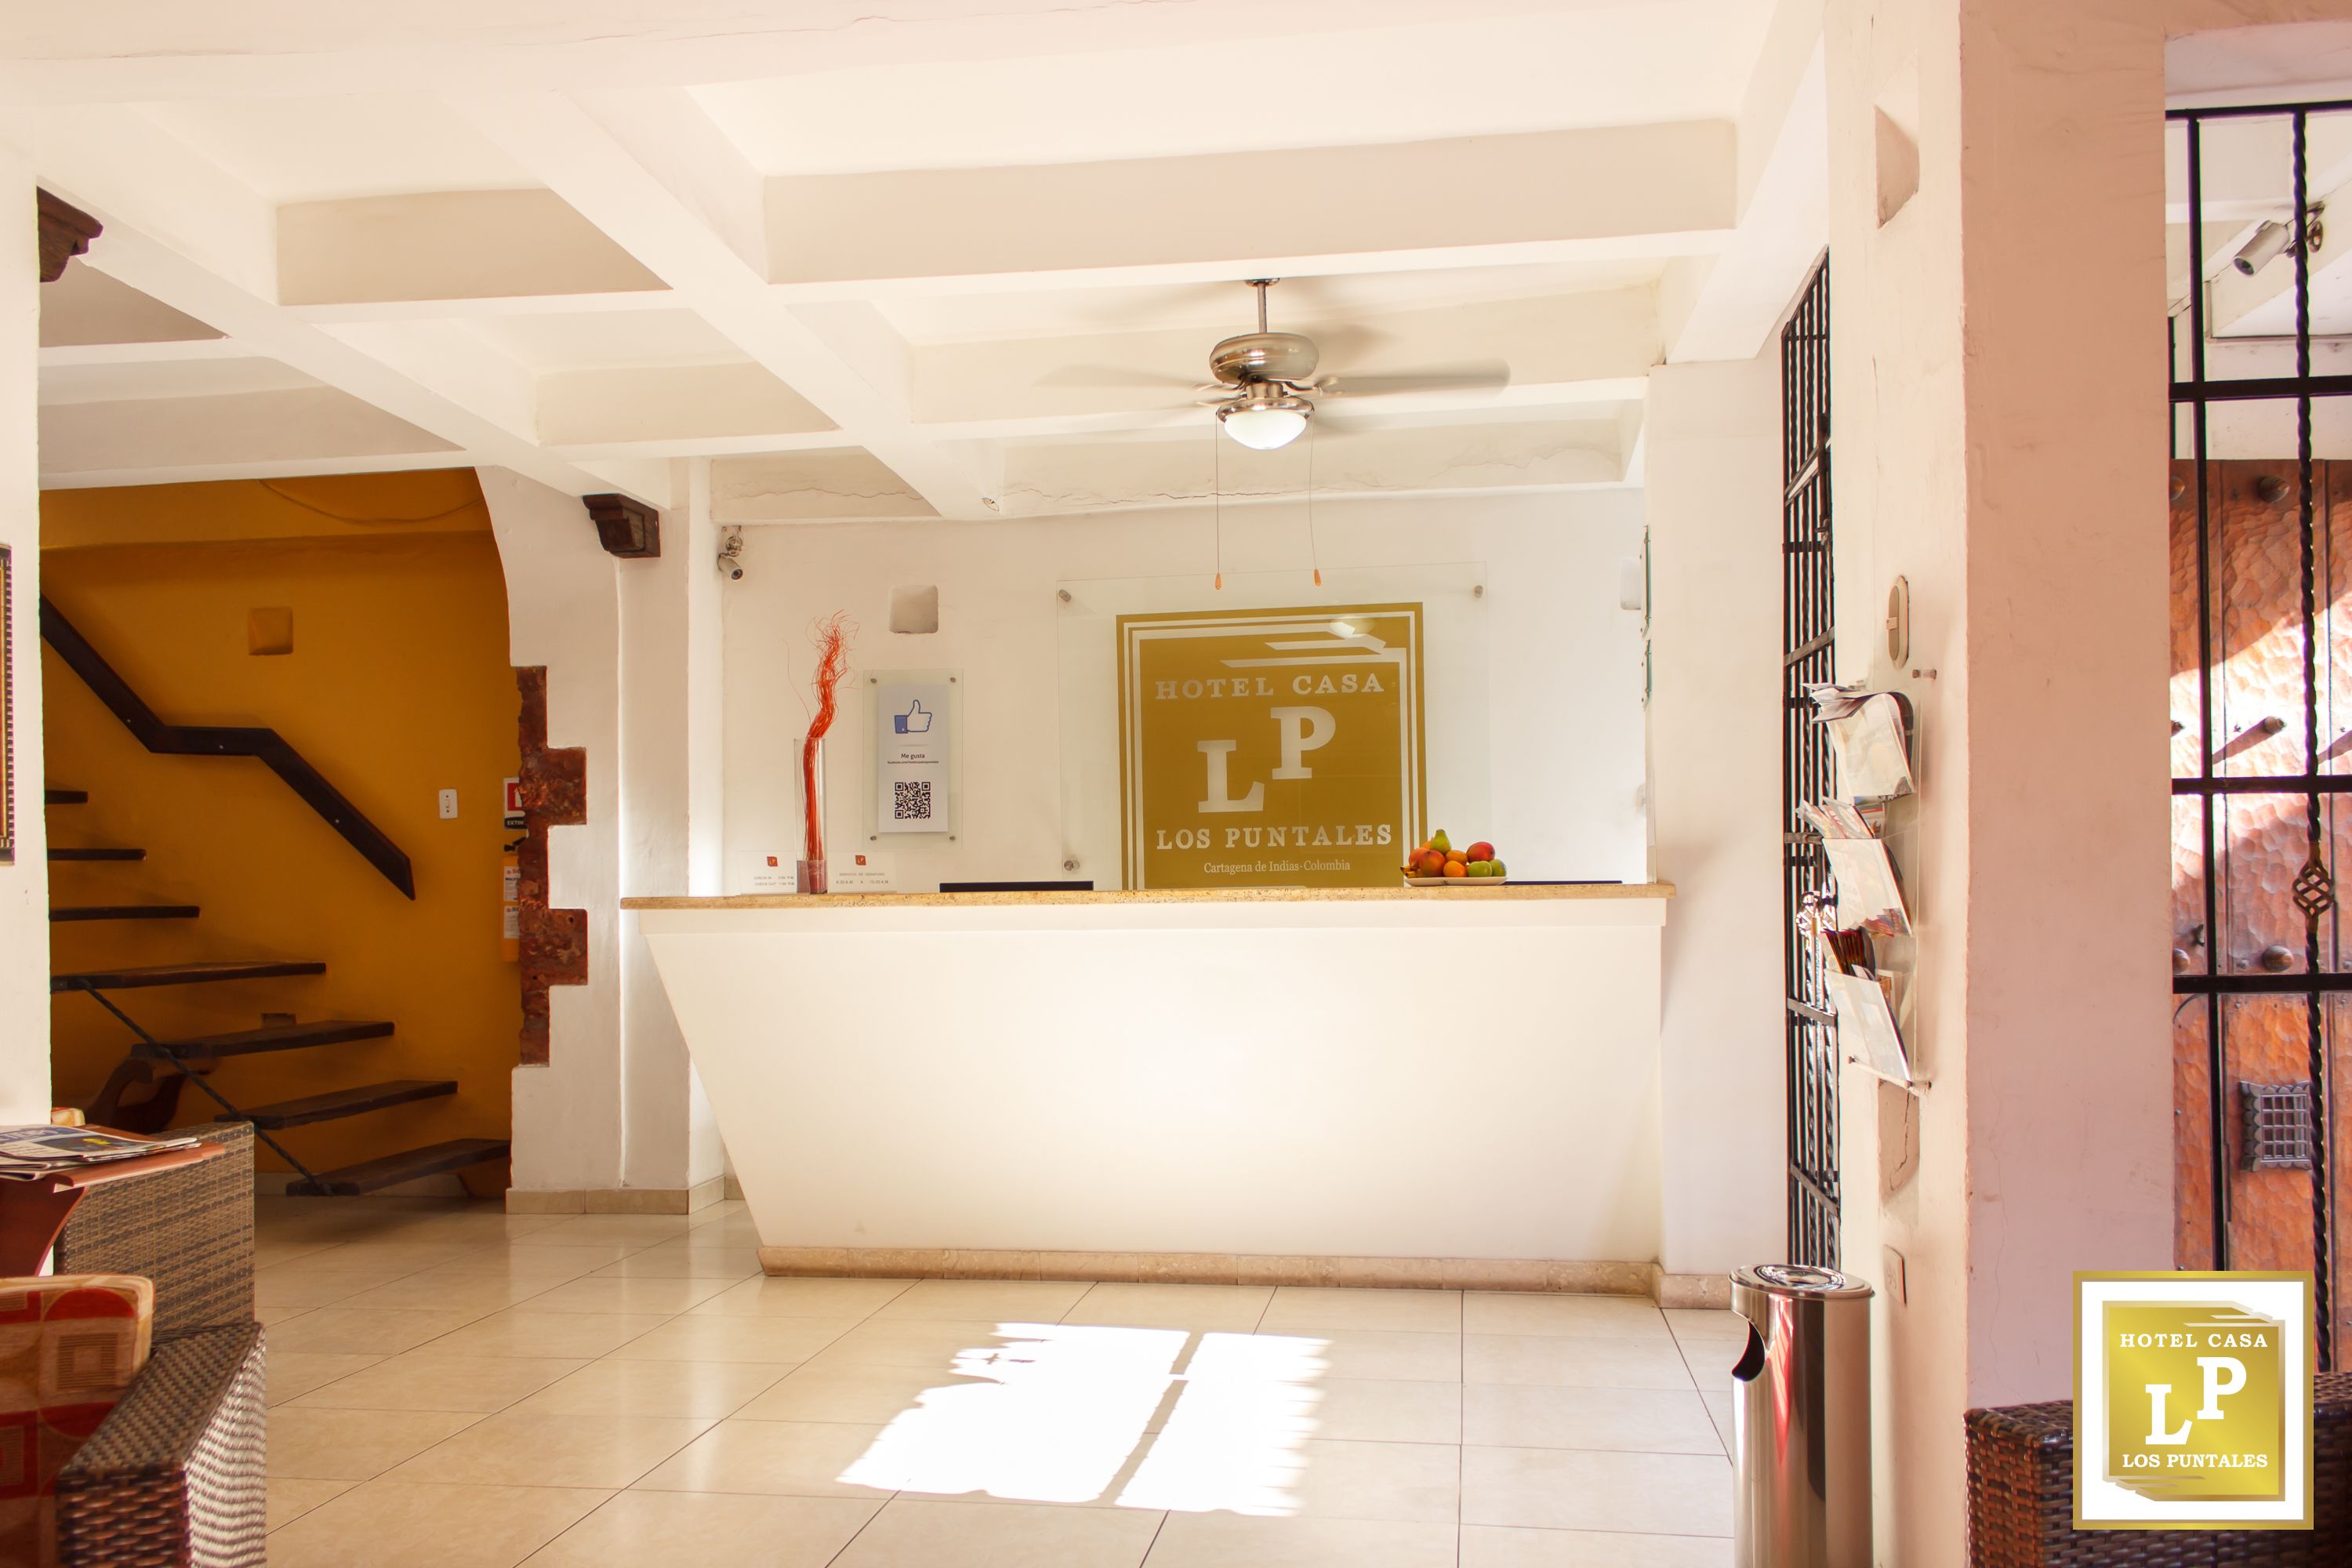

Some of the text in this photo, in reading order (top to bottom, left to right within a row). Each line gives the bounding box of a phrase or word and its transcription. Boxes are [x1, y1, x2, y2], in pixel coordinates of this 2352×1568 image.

[1155, 673, 1385, 700] HOTEL CASA
[1156, 823, 1392, 850] LOS PUNTALES
[1203, 862, 1253, 875] Cartagena
[1254, 861, 1267, 872] de
